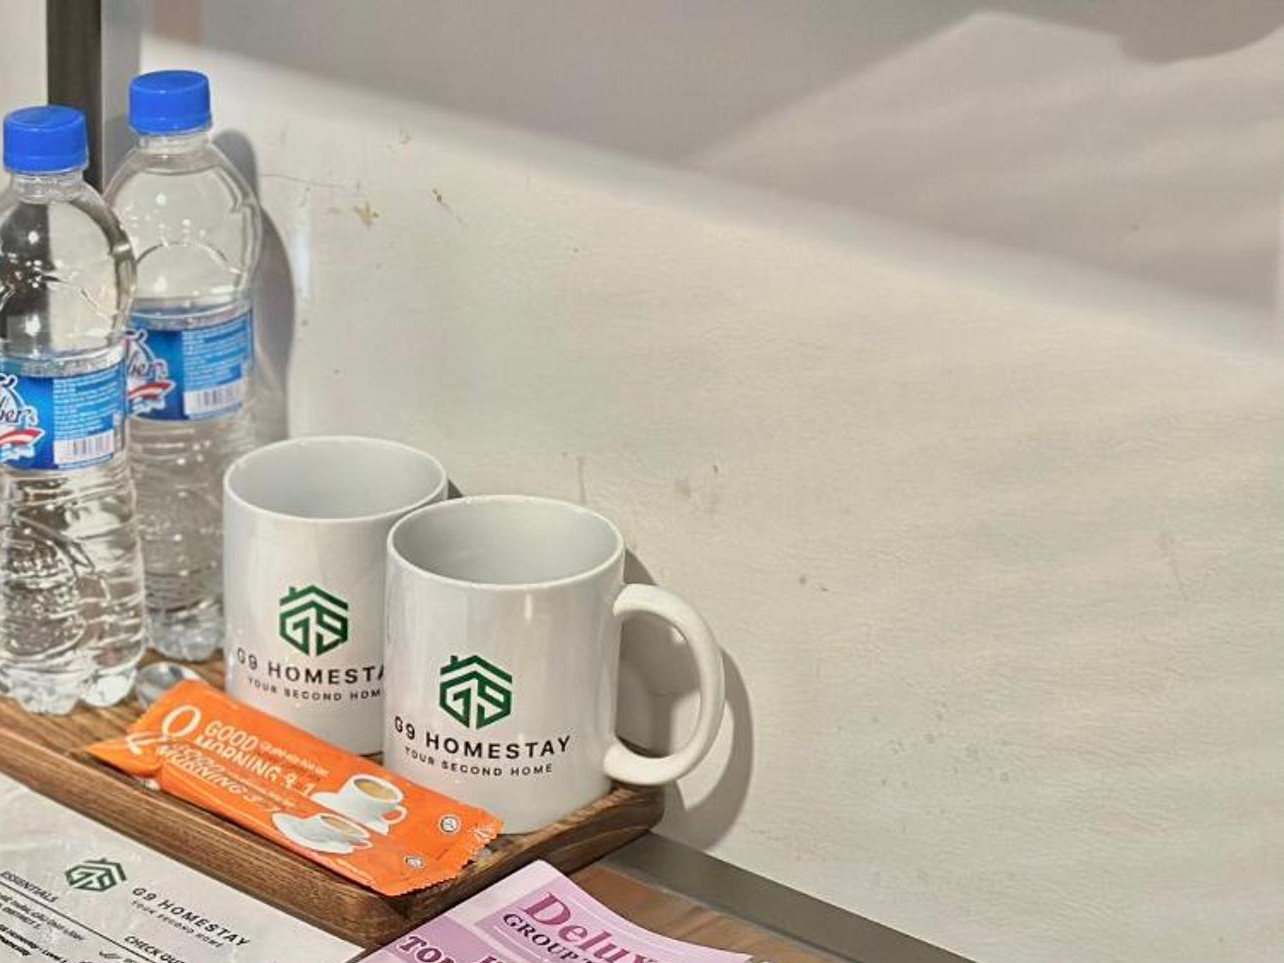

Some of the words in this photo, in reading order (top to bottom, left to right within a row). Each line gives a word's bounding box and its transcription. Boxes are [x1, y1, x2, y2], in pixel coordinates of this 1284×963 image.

[237, 647, 258, 670] G9
[268, 661, 385, 684] HOMEST
[248, 678, 276, 695] YOUR
[284, 688, 341, 701] SECOND
[350, 688, 384, 700] HOM
[204, 720, 259, 750] GOOD
[394, 716, 415, 740] G9
[426, 732, 571, 759] HOMESTAY
[405, 747, 435, 765] YOUR
[441, 760, 502, 777] SECOND
[510, 763, 552, 776] HOME
[156, 898, 250, 948] HOMESTAY
[122, 934, 163, 956] CHECK
